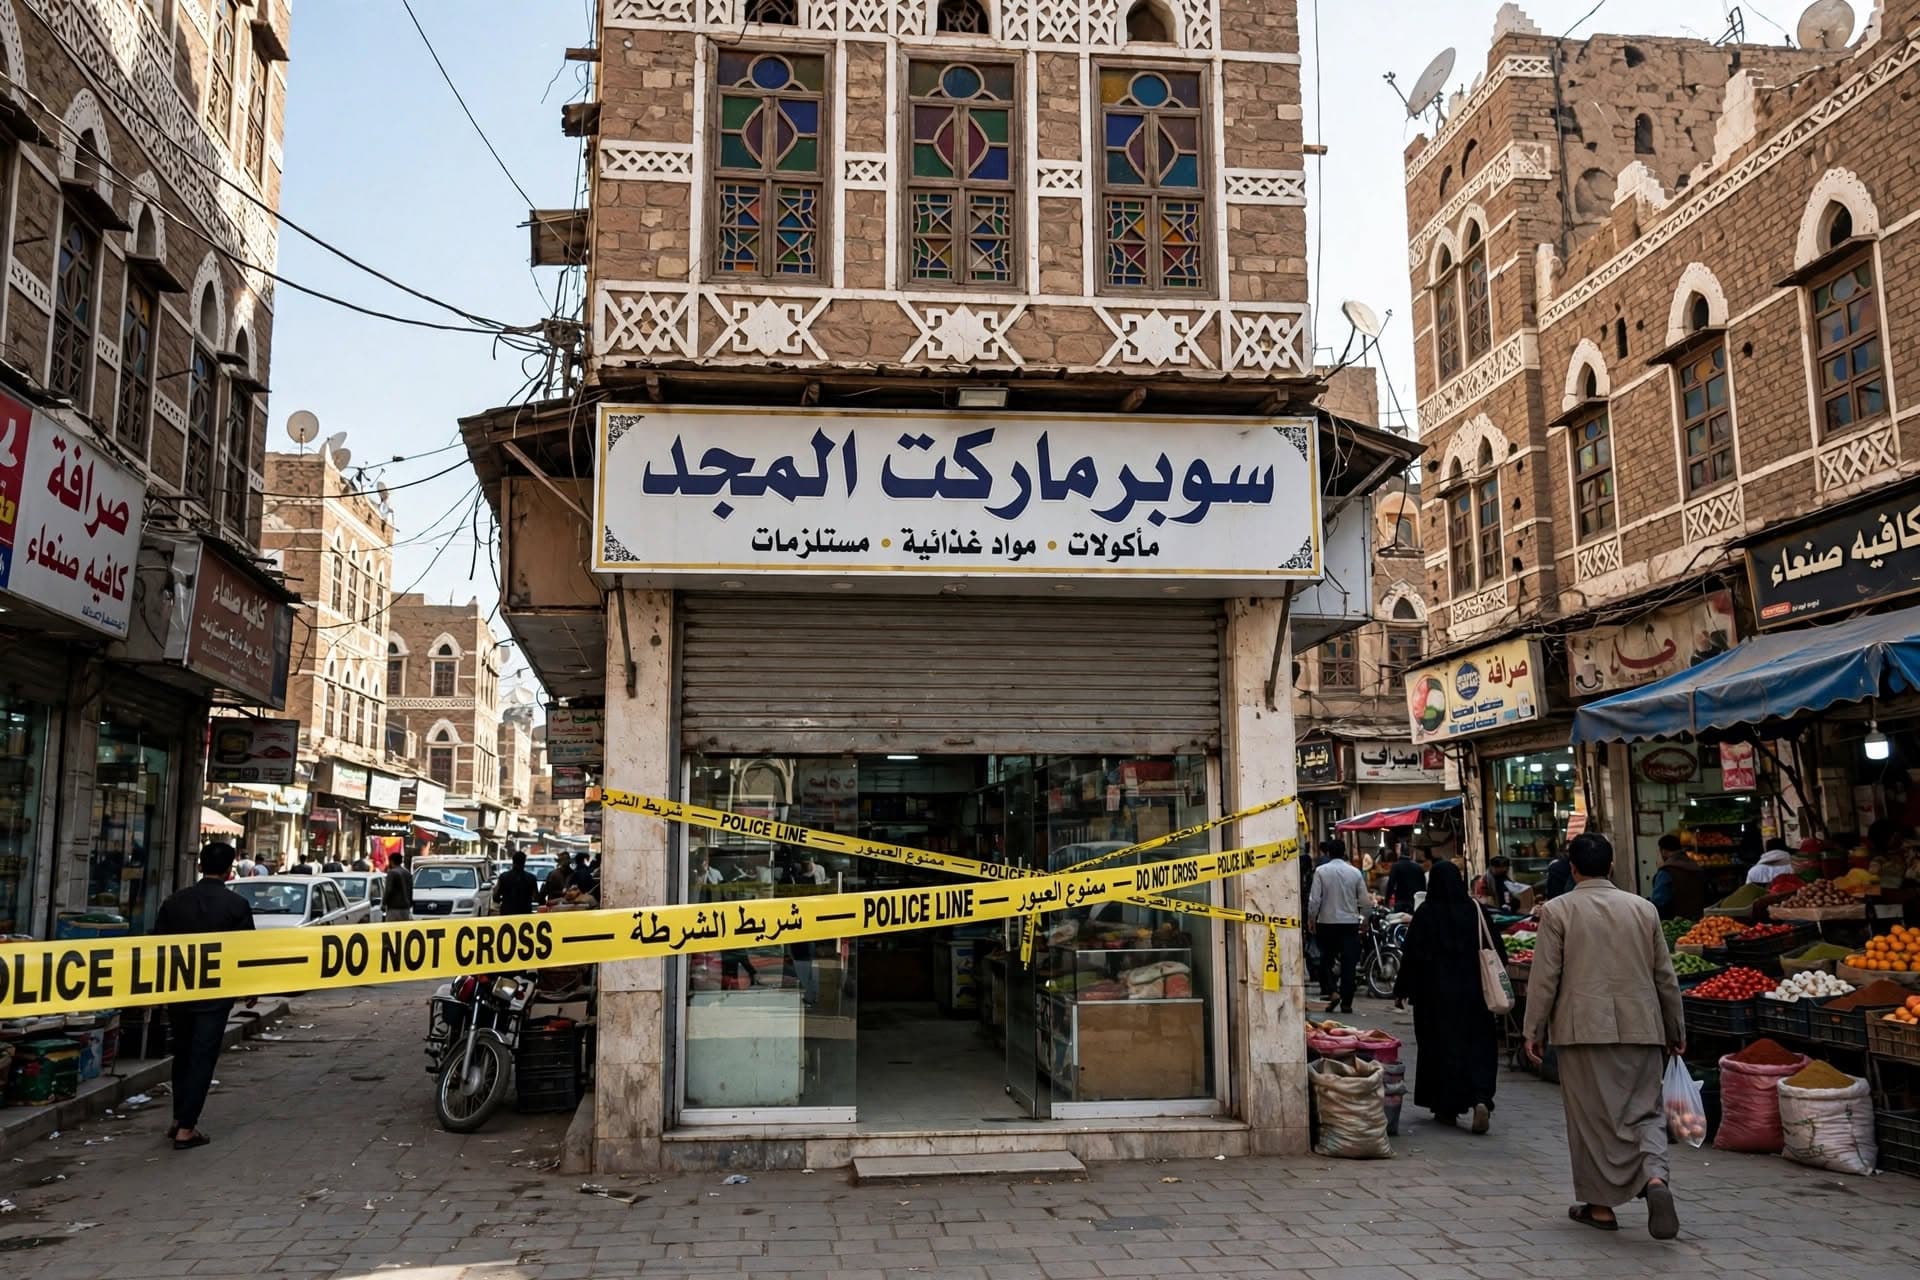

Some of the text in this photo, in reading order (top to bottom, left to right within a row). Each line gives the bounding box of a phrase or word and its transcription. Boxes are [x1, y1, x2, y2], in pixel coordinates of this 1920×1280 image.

[47, 434, 129, 537] صرافة
[642, 426, 858, 520] المجد
[26, 523, 128, 603] كافيه صنعاء
[751, 527, 1160, 562] مأكولات مواد غذائية مستلزمات
[1771, 541, 1843, 587] صنعاء
[1486, 655, 1528, 688] صرافة
[720, 813, 809, 844] POLICE LINE
[1016, 881, 1061, 912] العبور
[1066, 877, 1106, 907] ممنوع
[1136, 860, 1198, 892] DO NOT CROSS
[630, 903, 803, 950] شريط الشرطة
[863, 889, 974, 928] POLICE LINE
[320, 920, 553, 978] DO NOT CROSS
[0, 942, 222, 1004] LICE LINE
